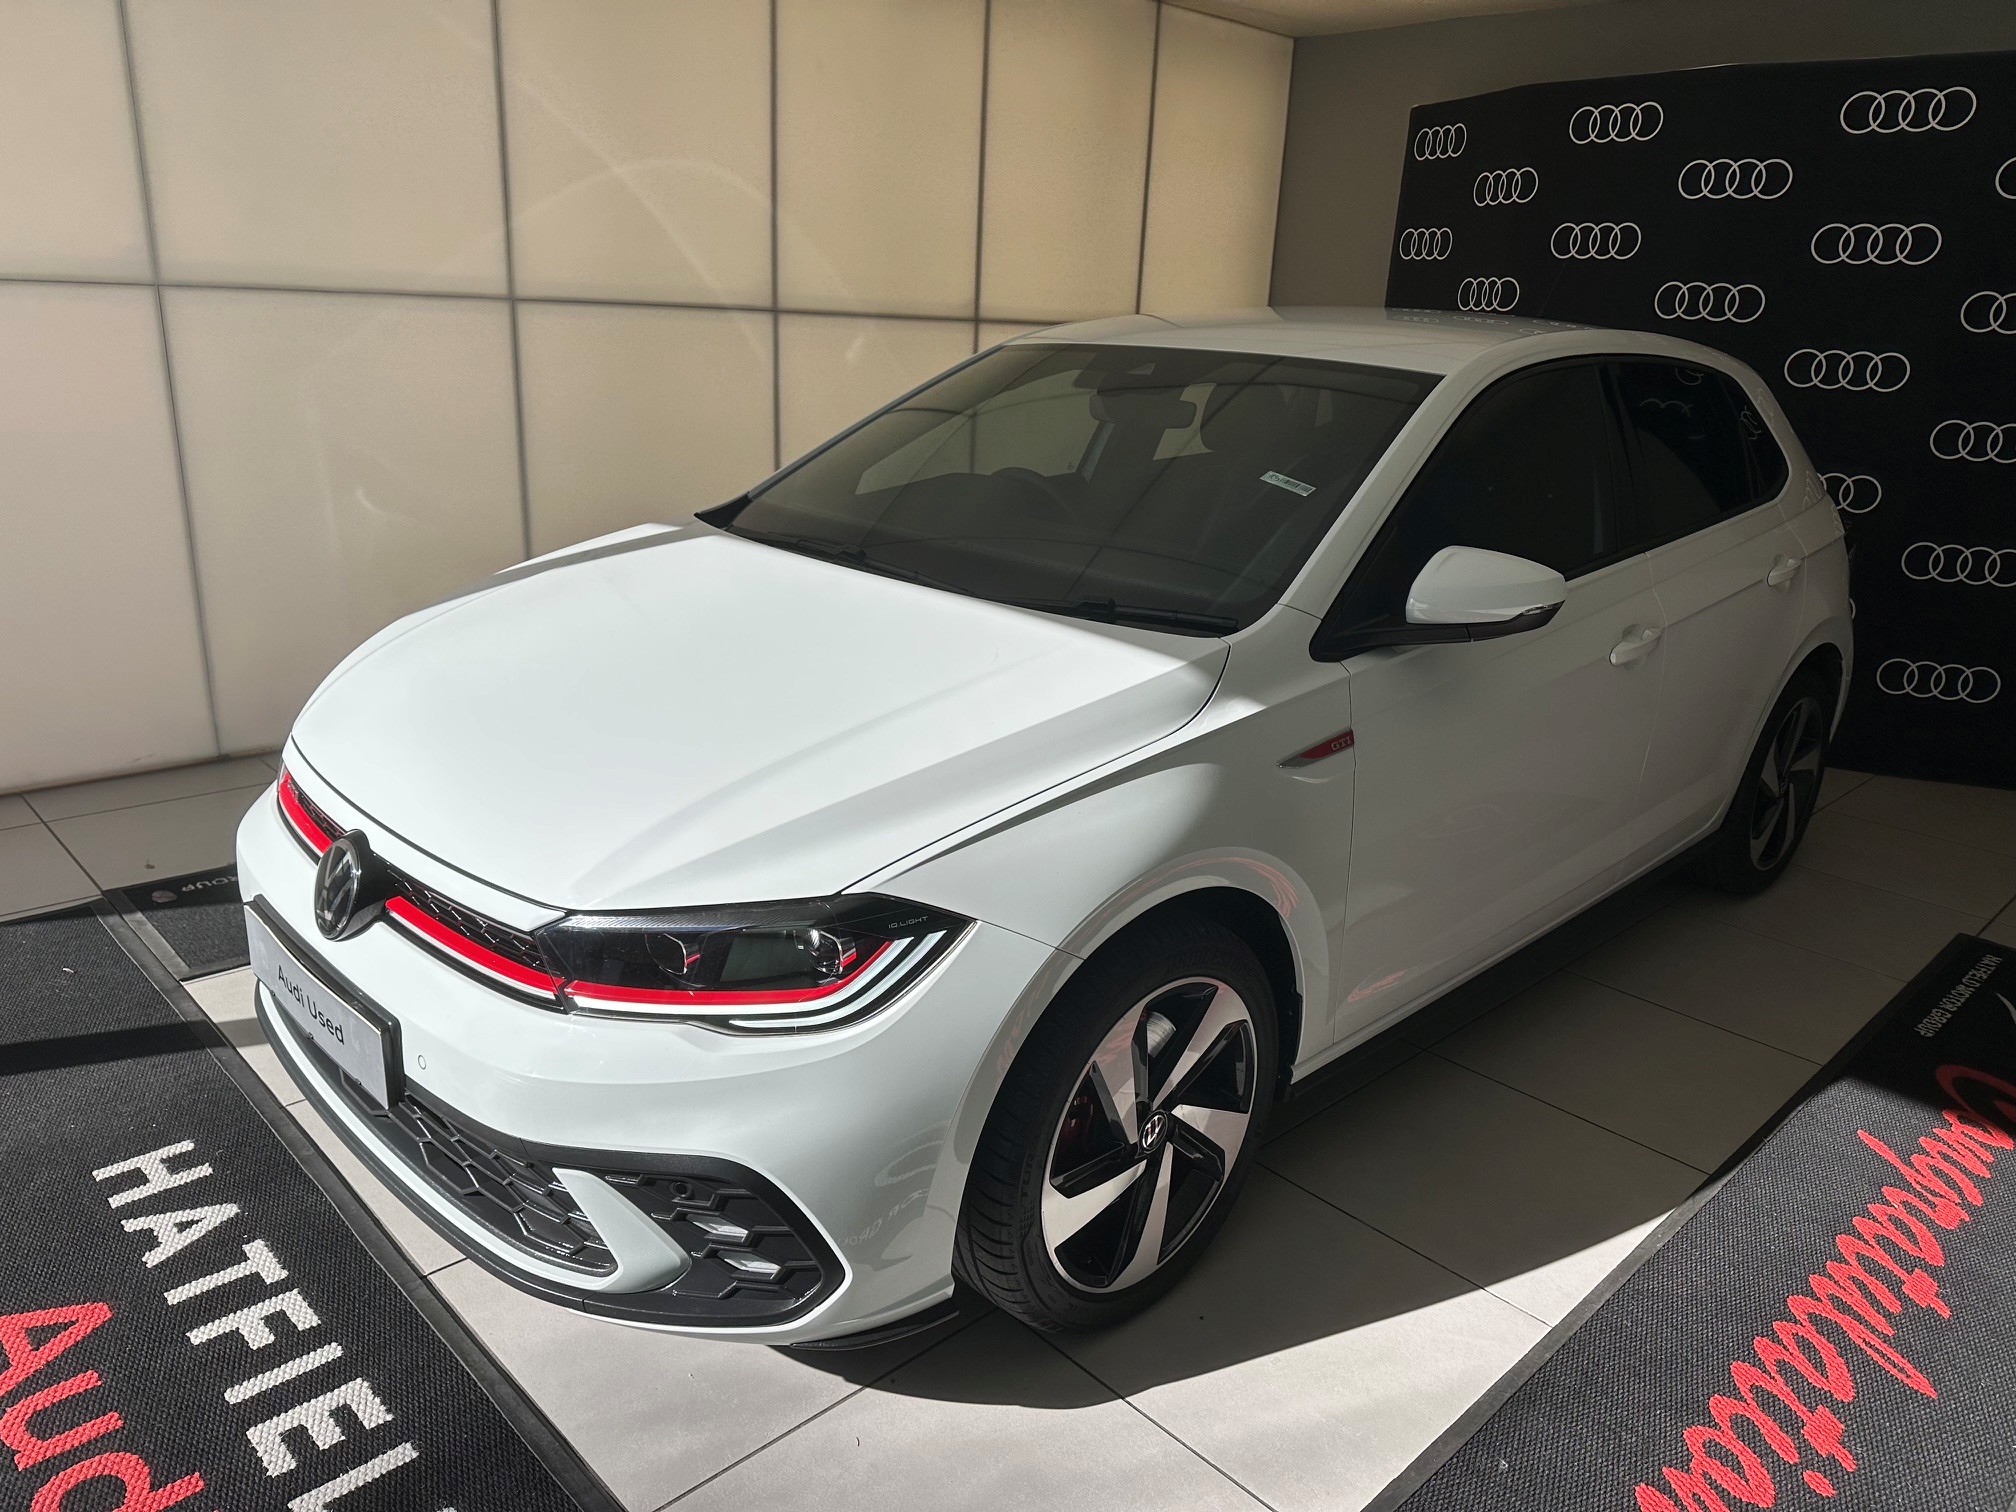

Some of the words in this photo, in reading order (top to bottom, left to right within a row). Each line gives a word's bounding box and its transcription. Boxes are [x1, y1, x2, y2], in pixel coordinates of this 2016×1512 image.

[278, 965, 305, 1008] Audi
[307, 995, 344, 1045] Used
[1914, 1008, 1952, 1037] GROUP
[92, 1139, 458, 1512] HATFIEL
[0, 1302, 222, 1512] Aud
